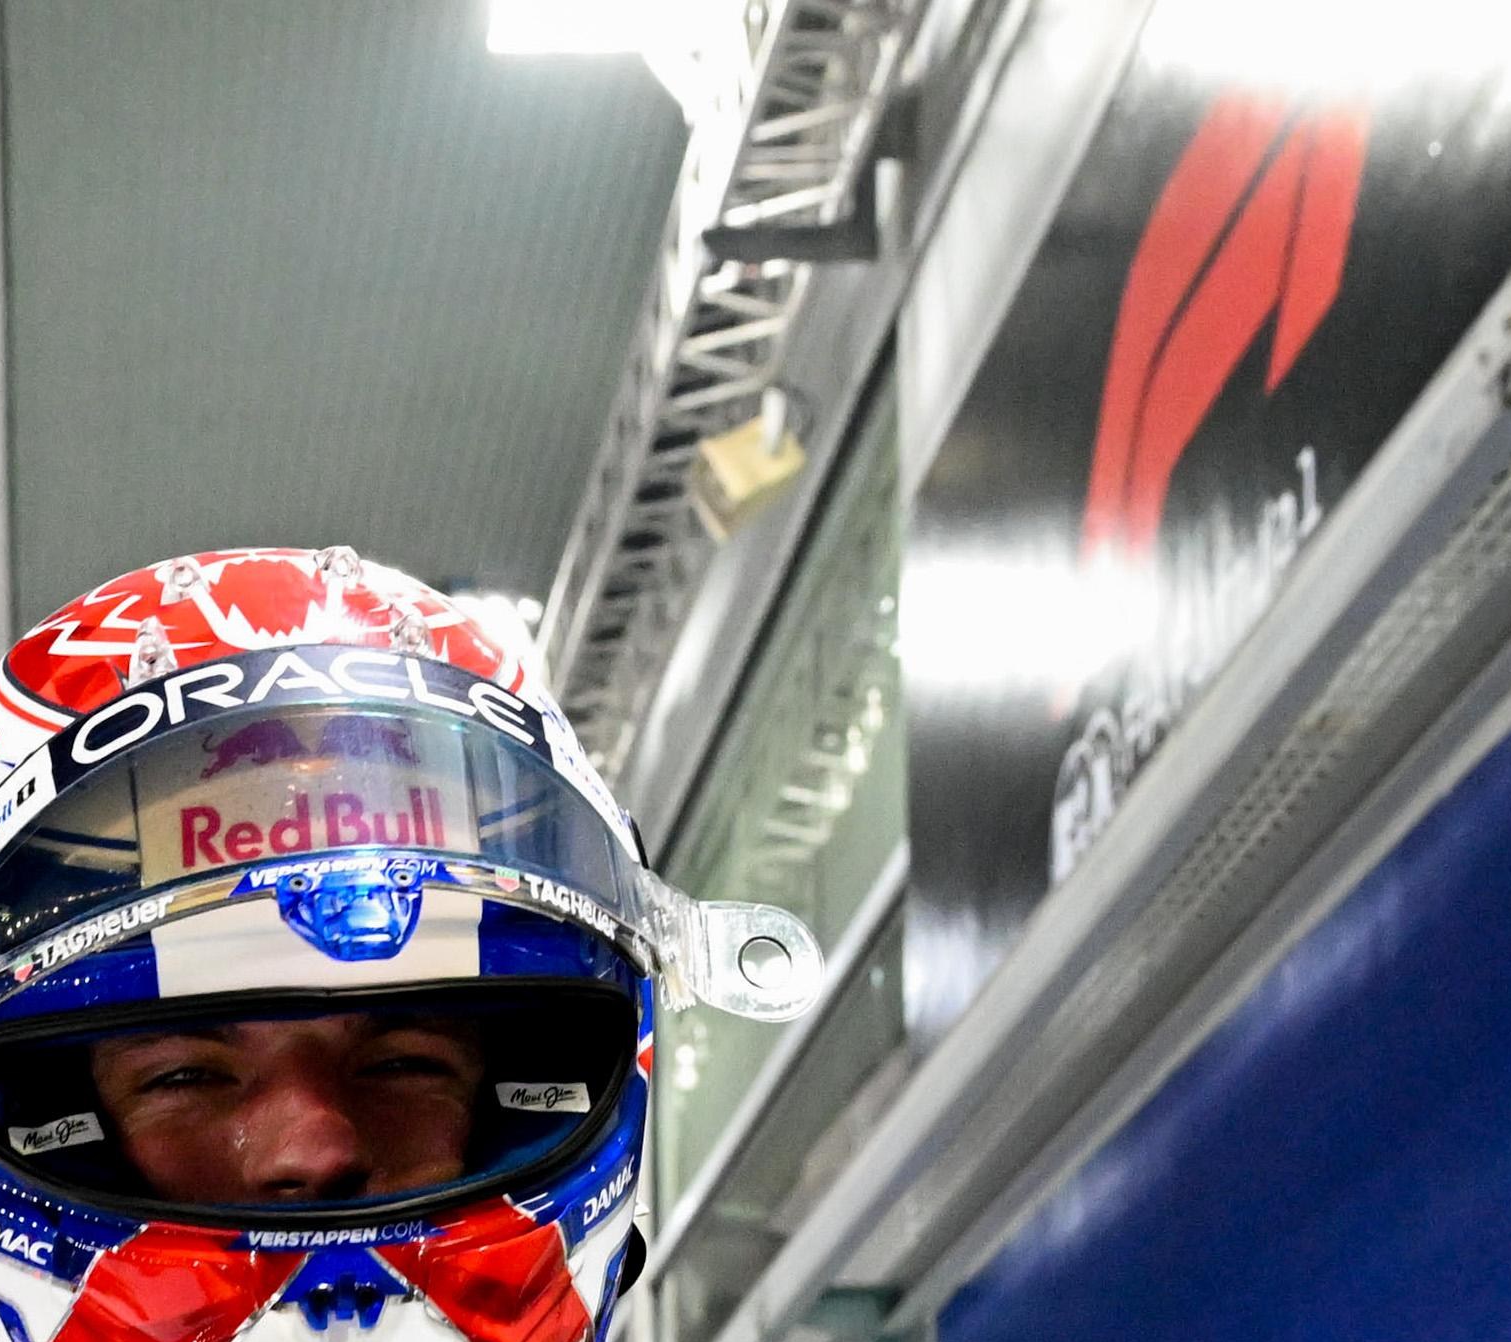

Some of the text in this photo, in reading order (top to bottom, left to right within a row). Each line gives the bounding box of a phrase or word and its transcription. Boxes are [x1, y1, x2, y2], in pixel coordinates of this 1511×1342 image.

[71, 650, 537, 764] ORACLE
[180, 787, 446, 868] Red Bull
[583, 1154, 635, 1226] DAMAC
[248, 1220, 423, 1247] VERSTAPPEN.COM
